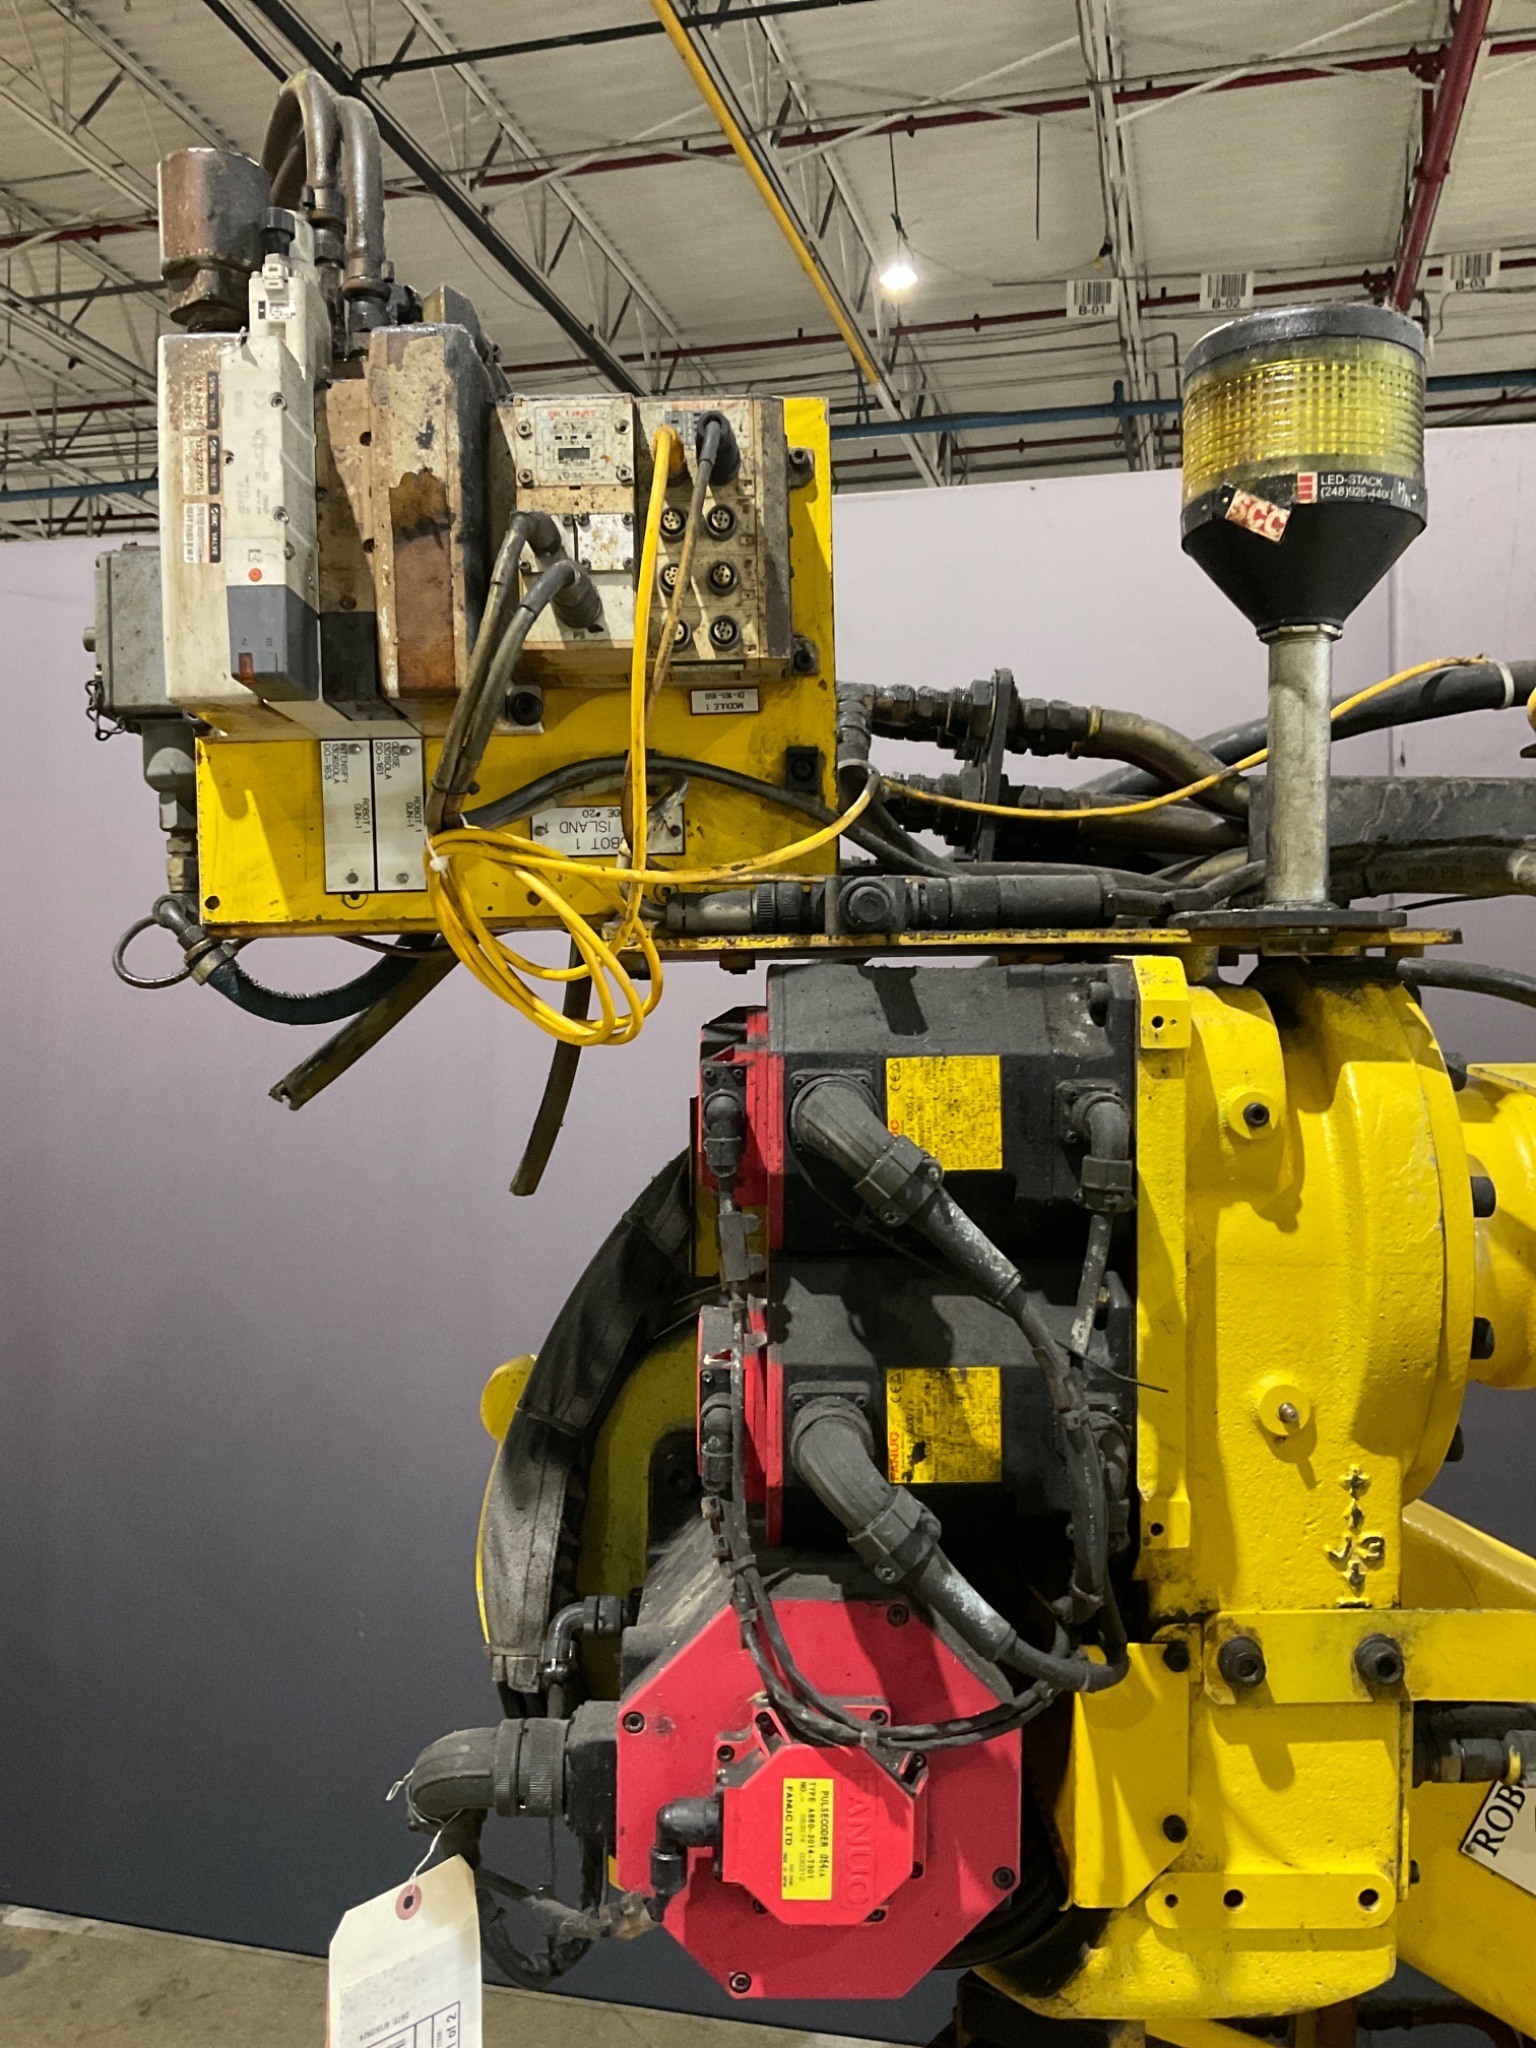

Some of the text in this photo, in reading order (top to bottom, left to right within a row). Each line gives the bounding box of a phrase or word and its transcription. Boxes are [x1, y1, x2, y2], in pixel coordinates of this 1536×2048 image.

[1456, 277, 1485, 290] B-03
[1079, 305, 1105, 315] B-01
[1212, 298, 1240, 308] B-02
[1321, 474, 1383, 486] LED-STACK
[323, 743, 331, 780] DO-163
[340, 743, 349, 784] INTENSIFY
[375, 742, 383, 775] DO-161
[384, 742, 392, 780] 1301SOLA
[391, 741, 400, 768] CLOSE
[354, 803, 362, 829] GUN-1
[362, 797, 370, 826] ROBOT
[405, 802, 414, 828] GUN-1
[414, 796, 422, 824] ROBOT
[559, 821, 611, 834] ISLAND
[575, 838, 580, 850] 1
[820, 1791, 829, 1847] PULSECODER
[846, 1771, 874, 1905] FANUC
[446, 2013, 457, 2023] 2
